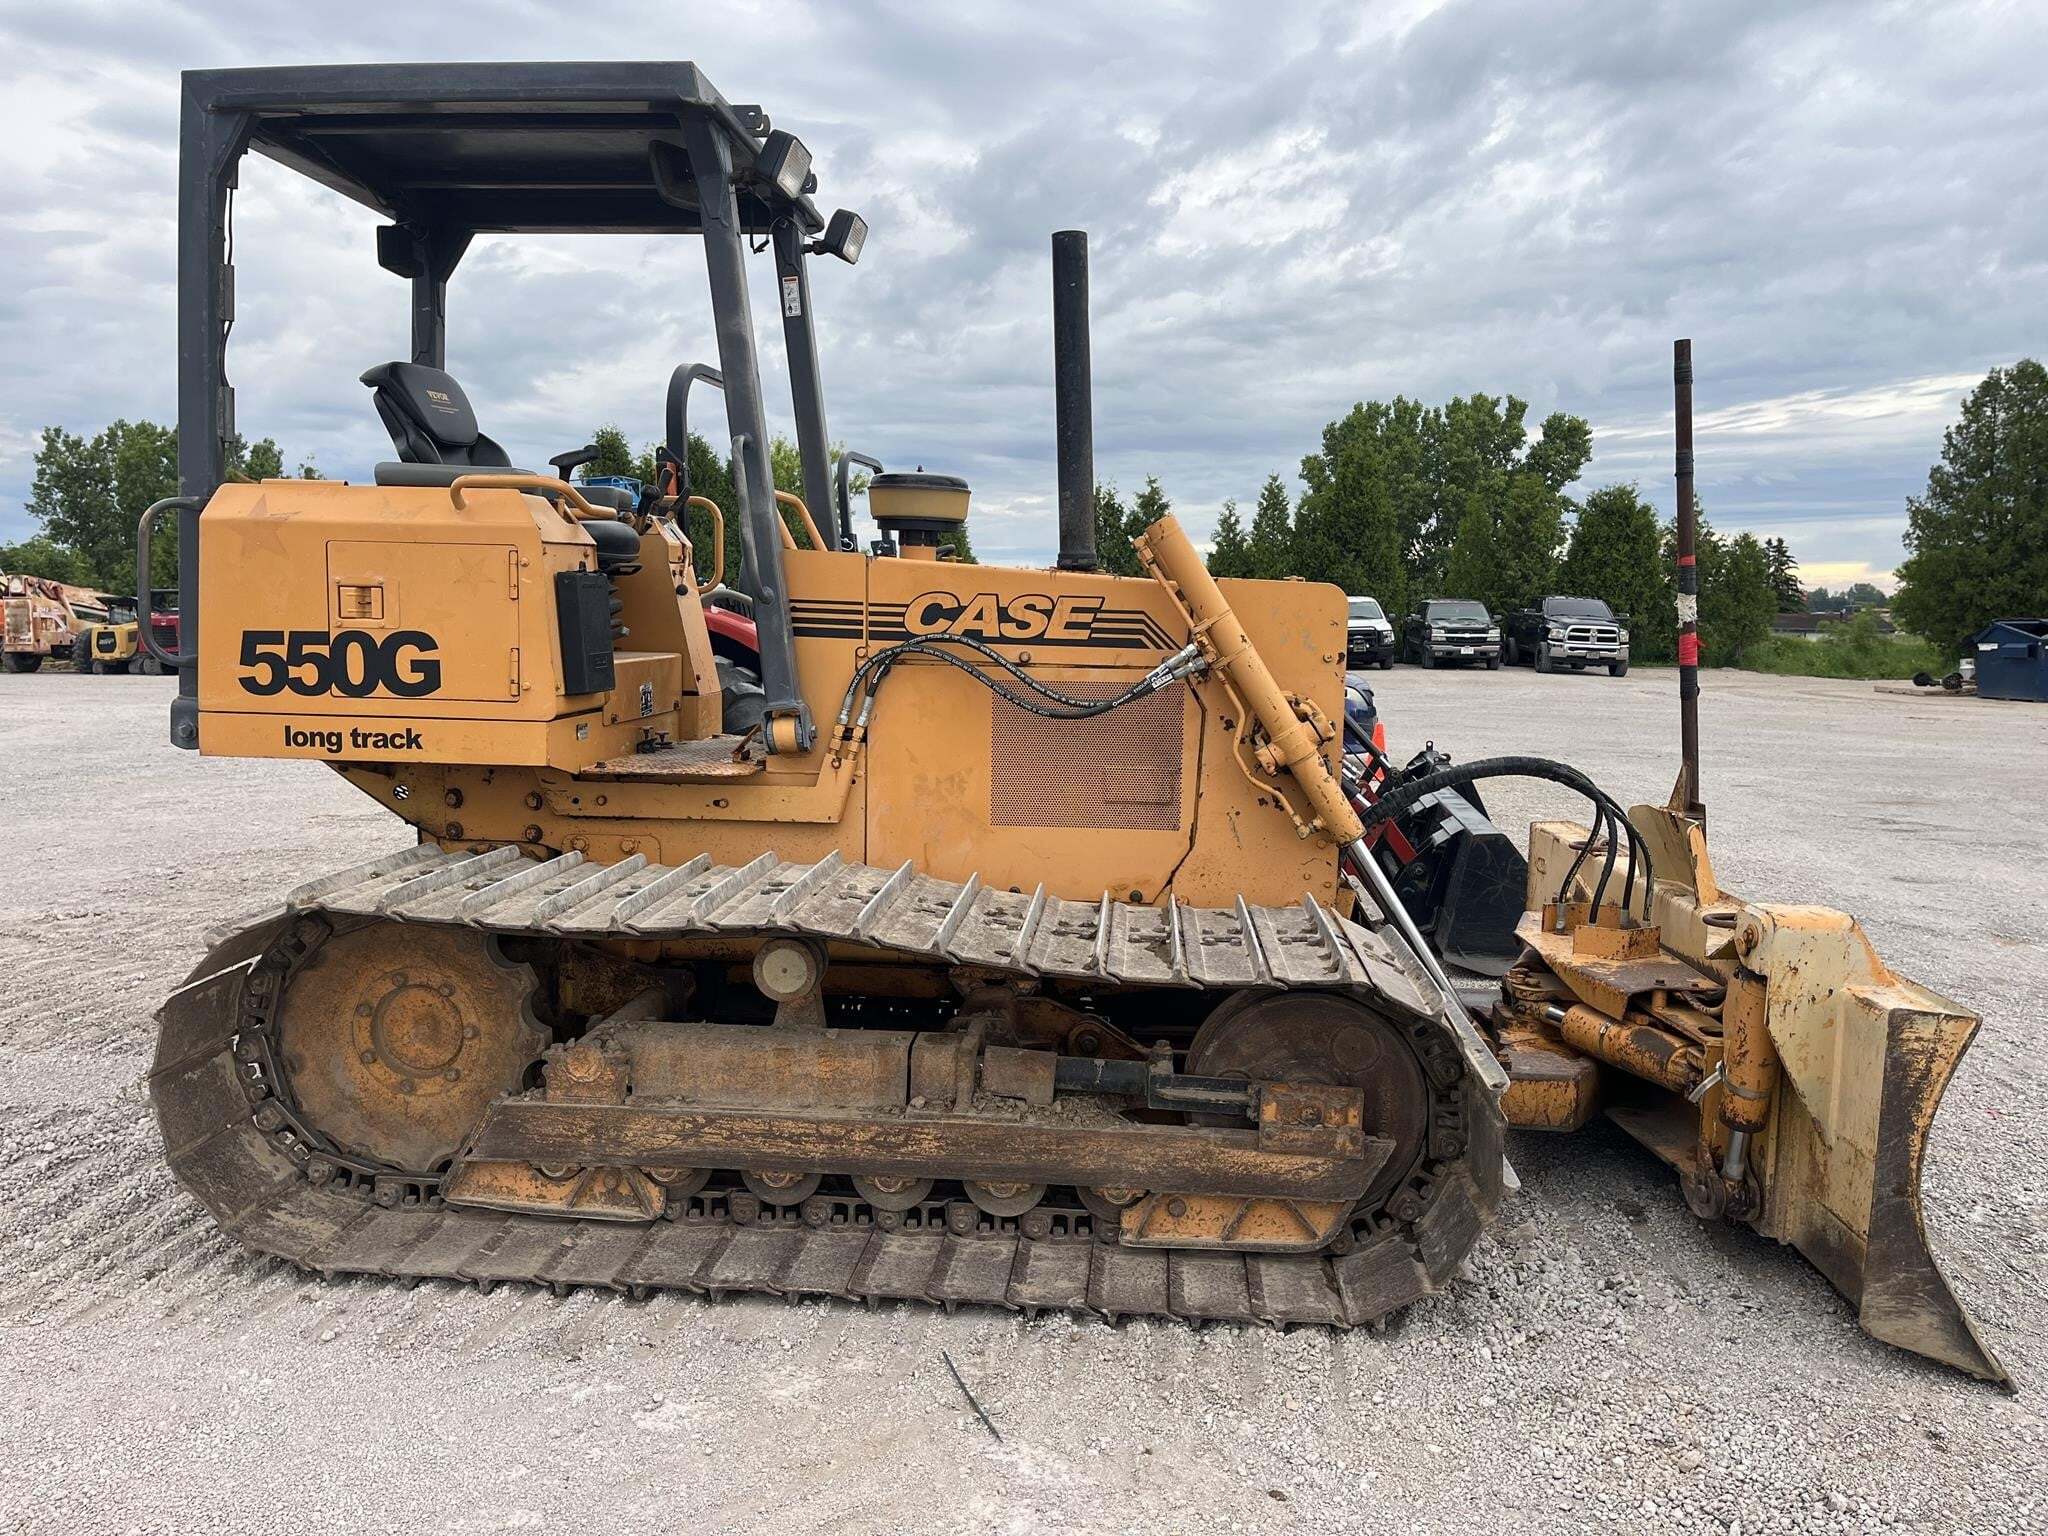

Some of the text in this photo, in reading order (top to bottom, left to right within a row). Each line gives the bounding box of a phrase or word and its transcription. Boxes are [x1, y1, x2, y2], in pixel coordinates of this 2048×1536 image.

[903, 590, 1106, 641] CASE
[239, 630, 441, 697] 550G
[284, 725, 423, 754] long track
